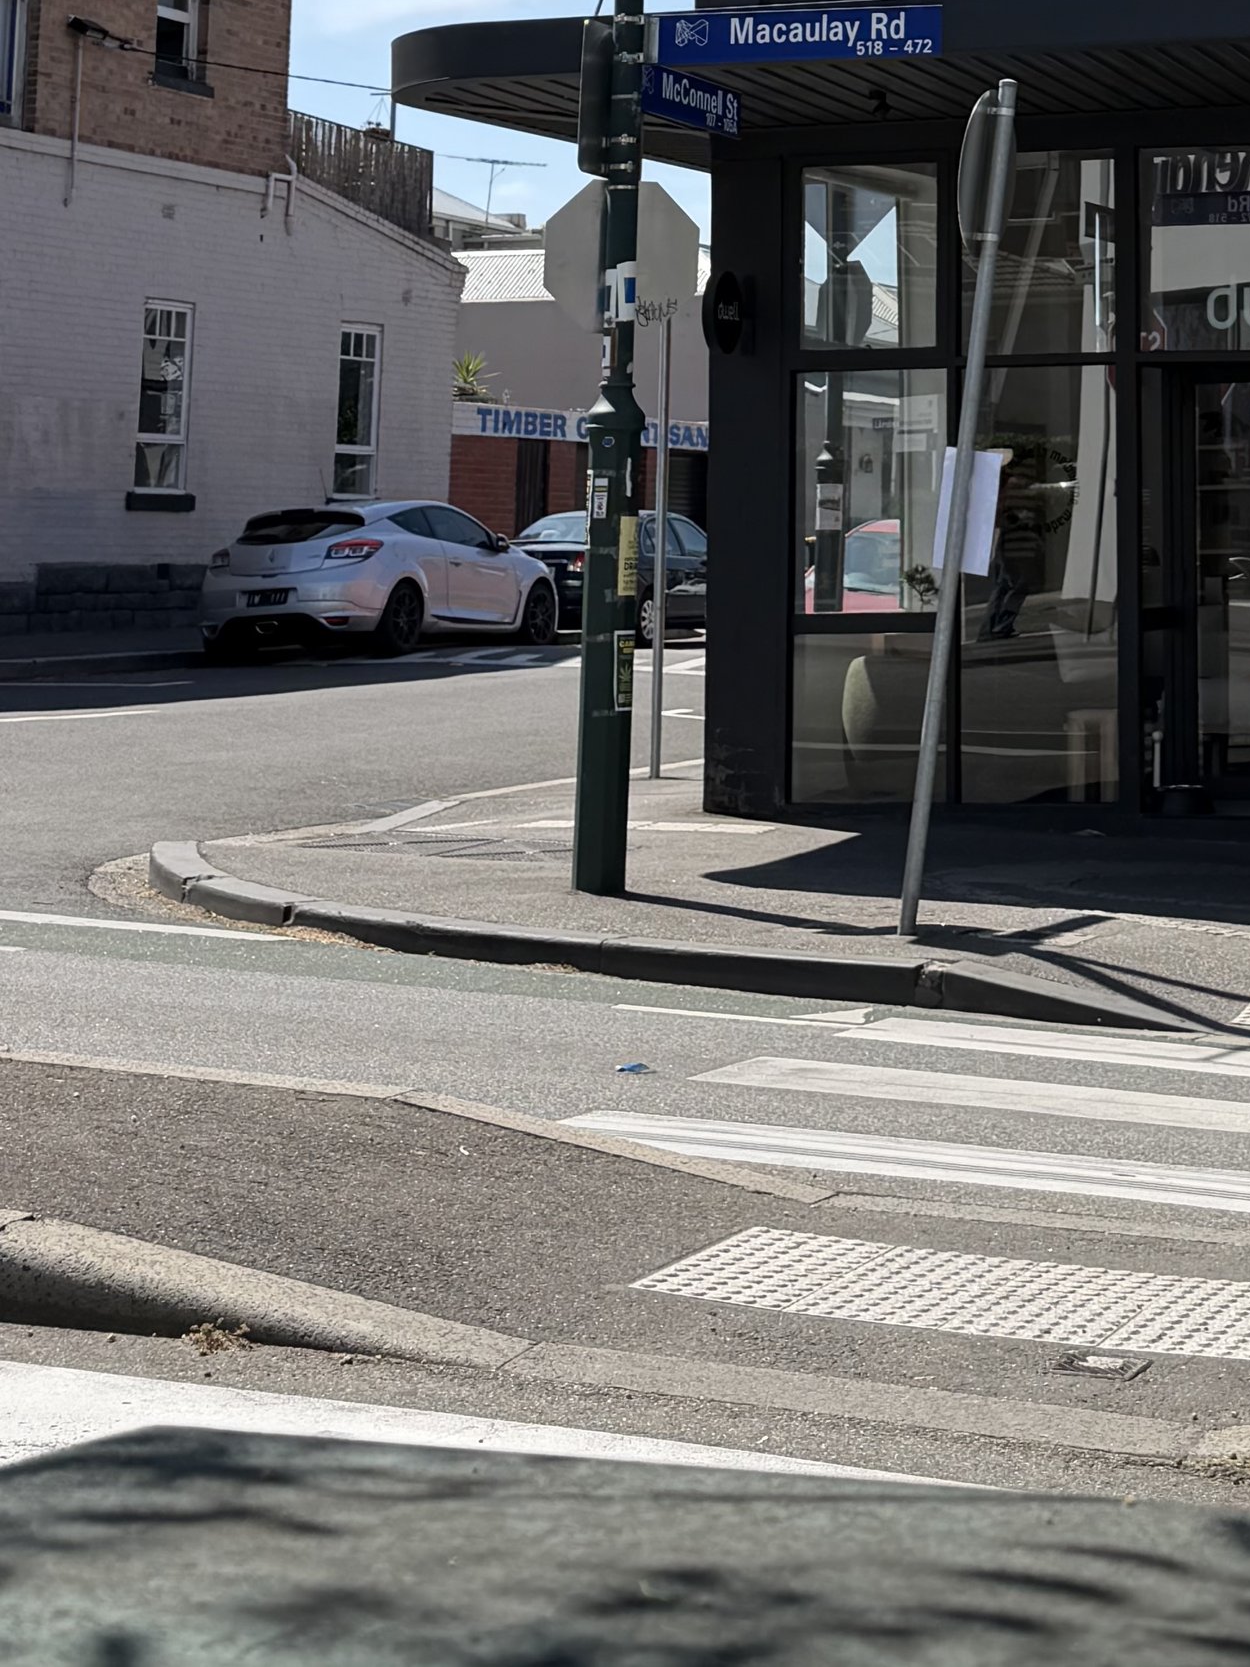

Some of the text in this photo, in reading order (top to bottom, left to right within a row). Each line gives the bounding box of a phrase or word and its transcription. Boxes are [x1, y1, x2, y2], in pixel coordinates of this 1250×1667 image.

[730, 11, 905, 47] Macaulay Rd
[856, 41, 883, 56] 518
[904, 39, 932, 54] 472
[662, 72, 738, 120] McConnell St
[717, 301, 740, 321] dwell
[477, 407, 567, 438] TIMBER
